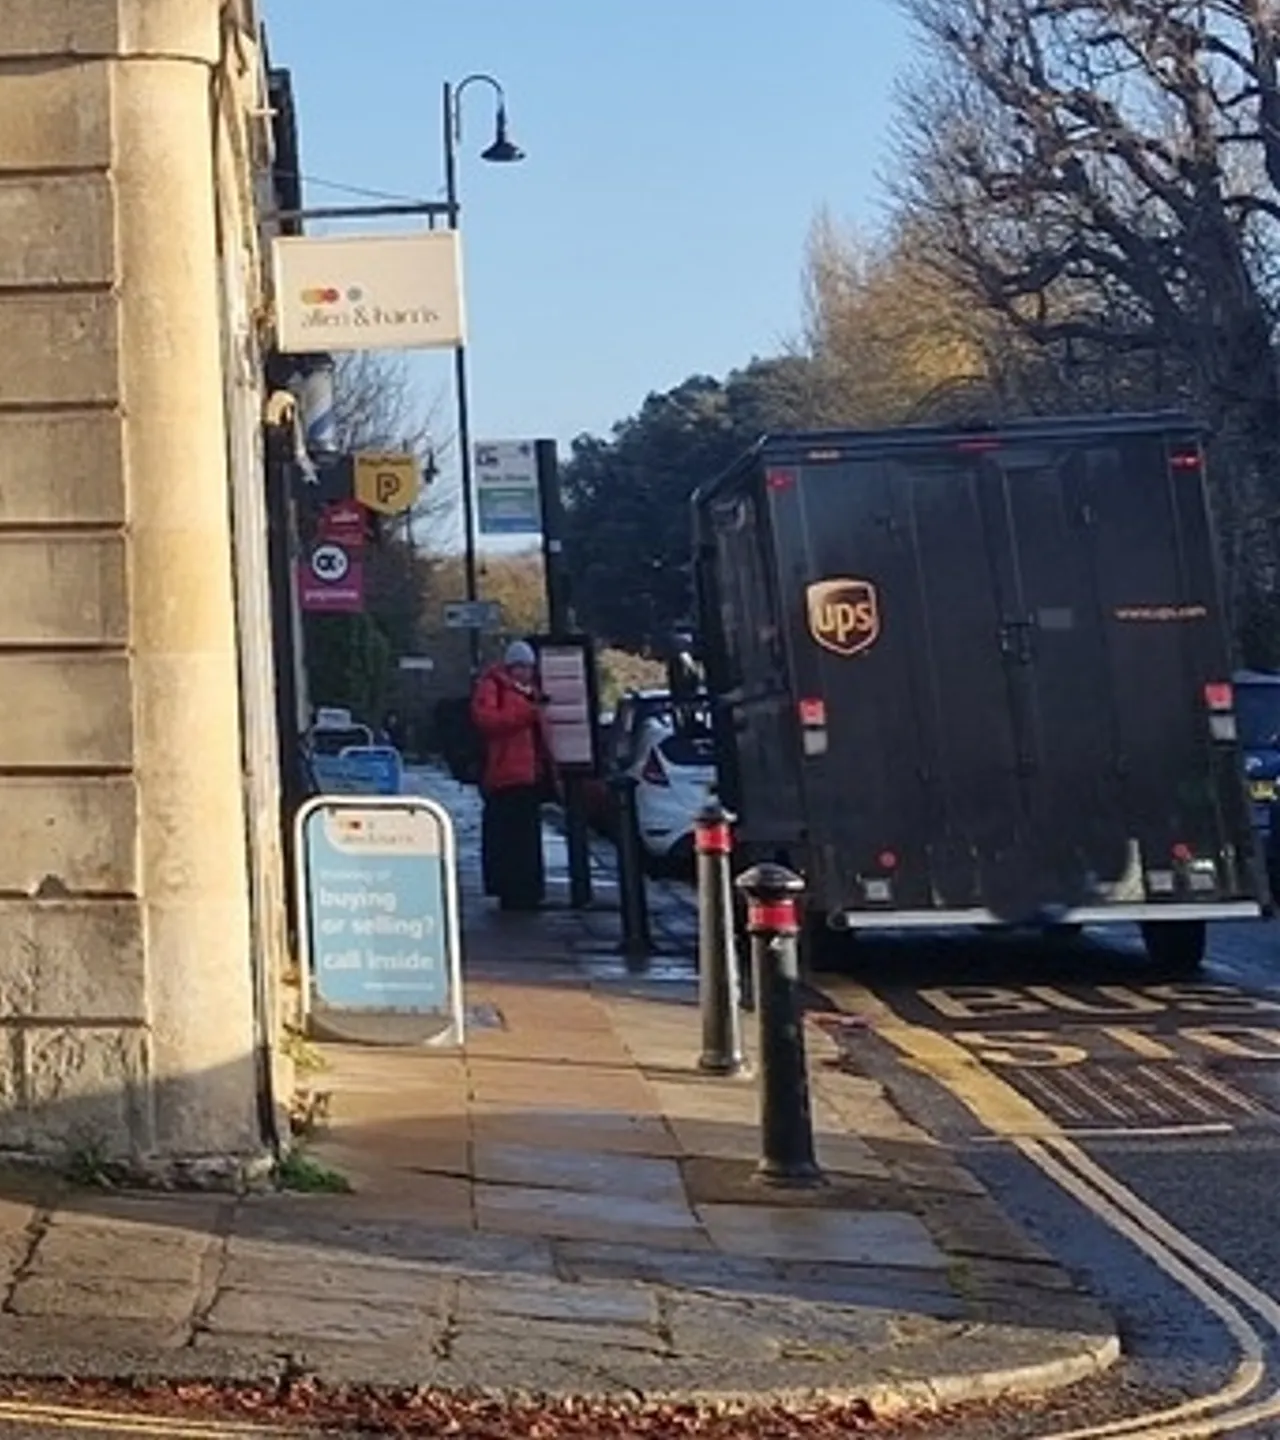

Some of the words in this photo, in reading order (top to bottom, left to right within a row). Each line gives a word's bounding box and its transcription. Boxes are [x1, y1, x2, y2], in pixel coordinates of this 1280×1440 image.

[816, 602, 873, 643] ups
[320, 886, 397, 913] buying
[320, 919, 345, 935] or
[917, 984, 1262, 1019] BUS
